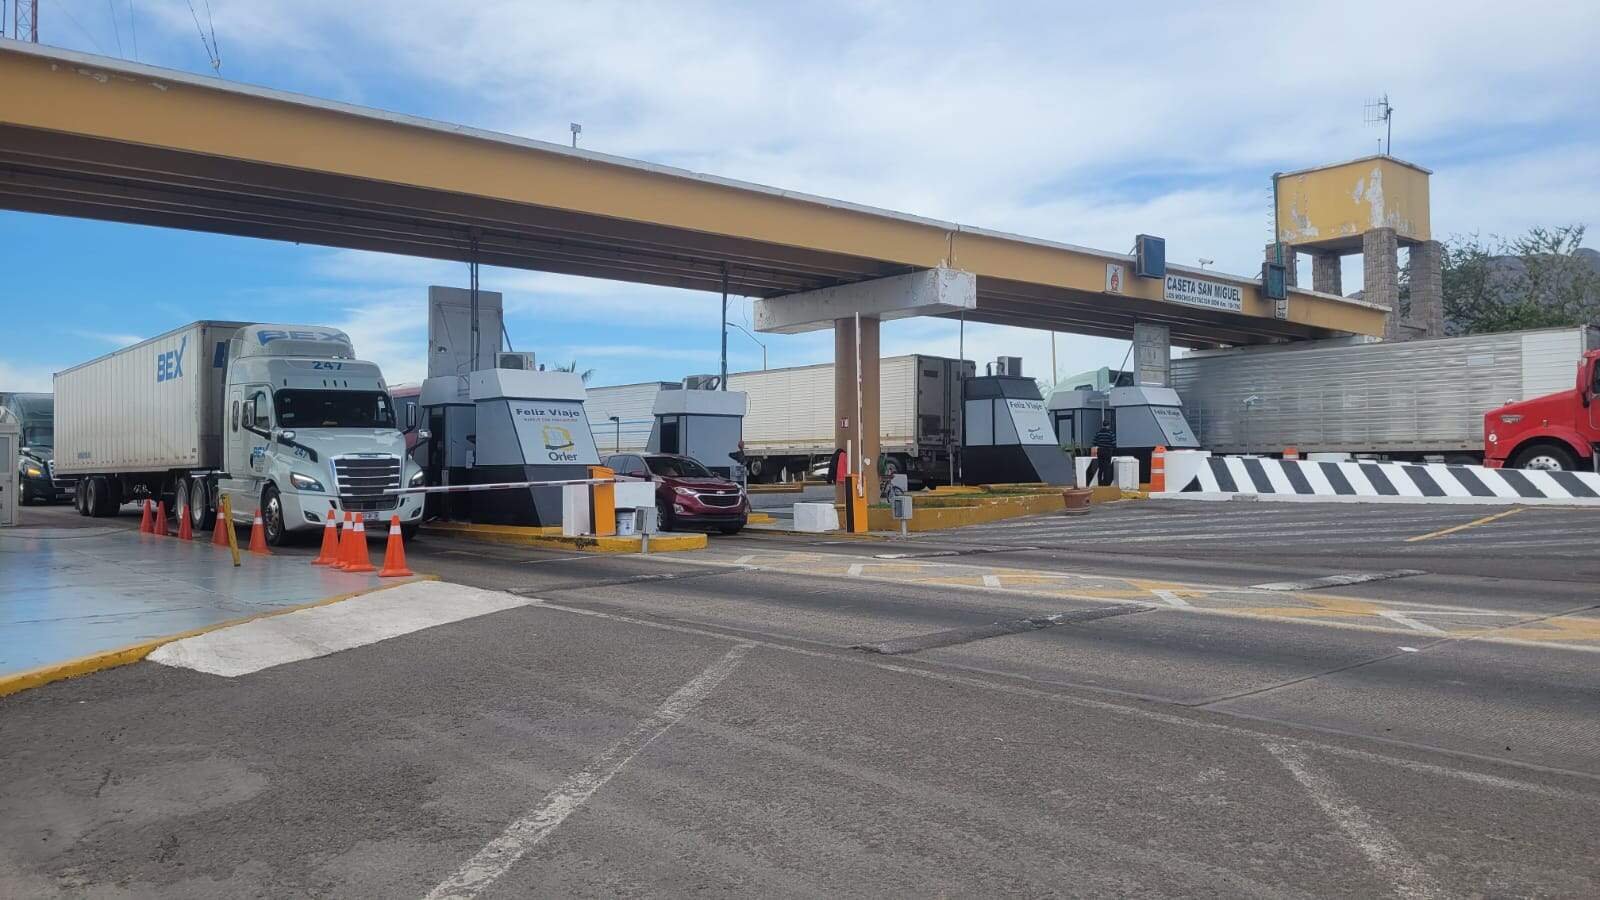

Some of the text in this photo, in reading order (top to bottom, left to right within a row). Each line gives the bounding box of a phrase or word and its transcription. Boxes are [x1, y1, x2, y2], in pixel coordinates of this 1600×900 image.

[1167, 276, 1241, 301] CASETA SAN MIGUEL
[257, 330, 350, 346] BEX
[157, 334, 187, 383] BEX
[312, 361, 342, 370] 247
[516, 408, 580, 418] Feliz Viaje
